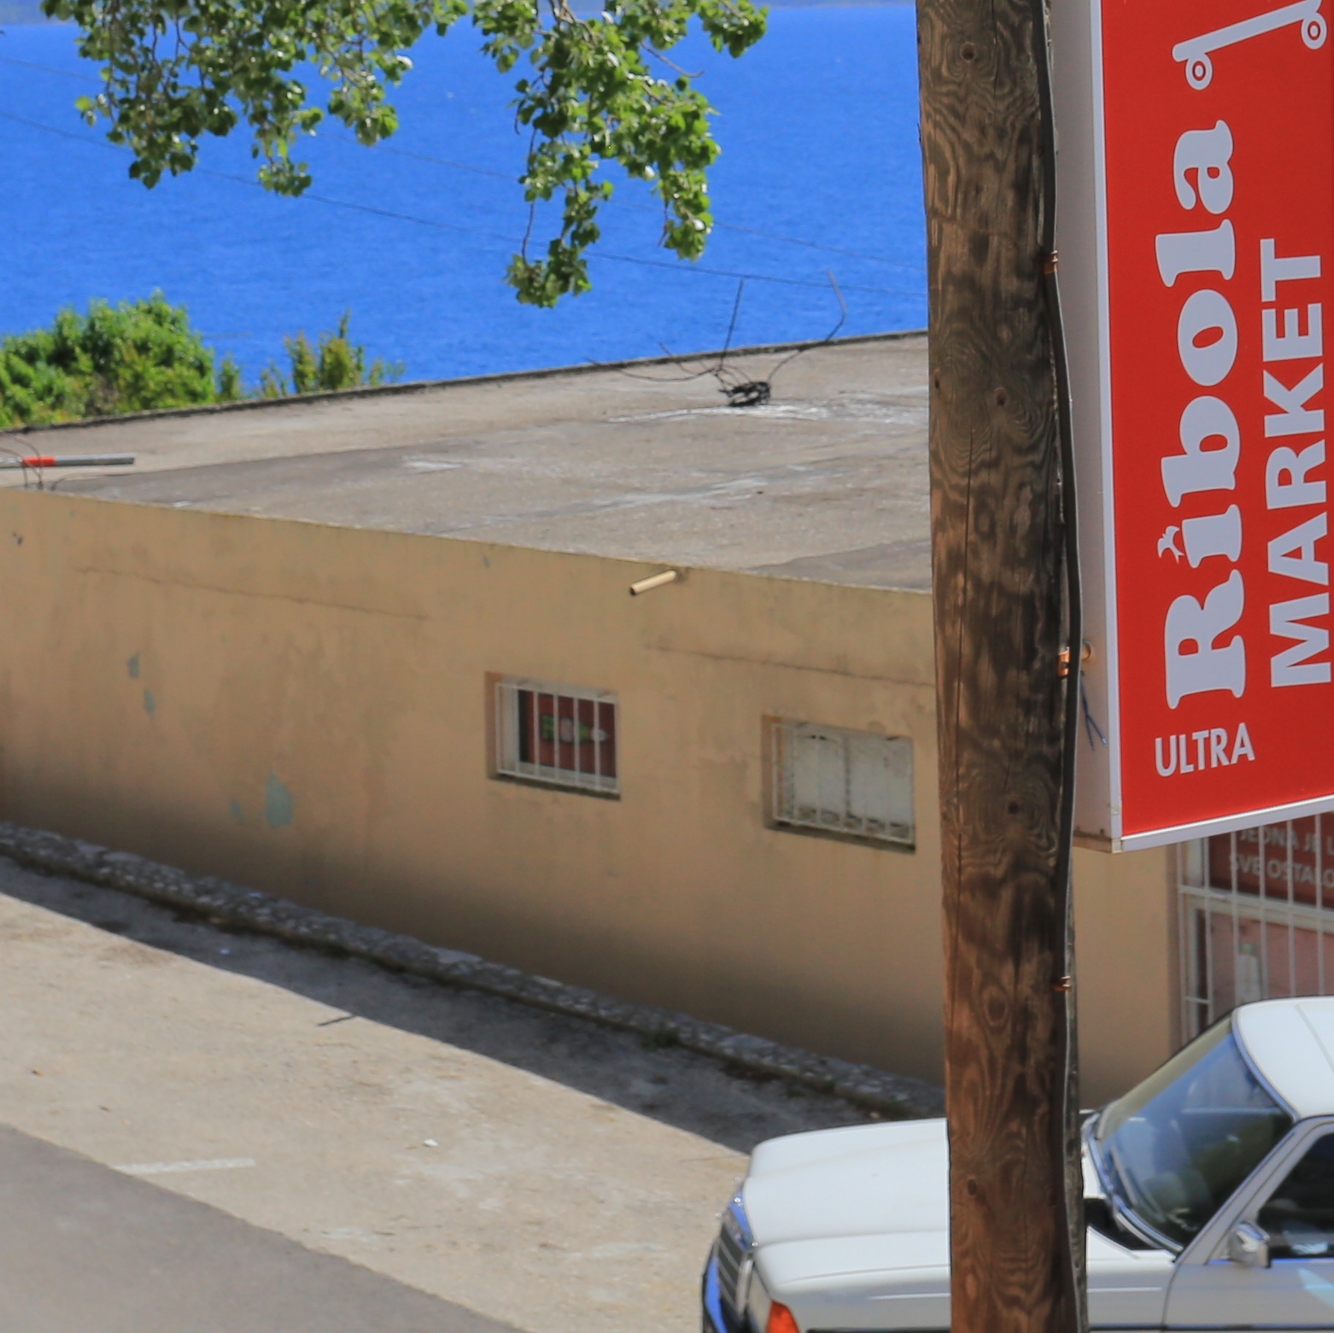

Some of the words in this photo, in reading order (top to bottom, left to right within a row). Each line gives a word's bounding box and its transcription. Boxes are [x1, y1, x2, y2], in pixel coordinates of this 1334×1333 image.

[1155, 119, 1246, 709] Ribola
[1259, 237, 1332, 688] MARKET
[1154, 722, 1256, 777] ULTRA
[1230, 853, 1264, 877] VE
